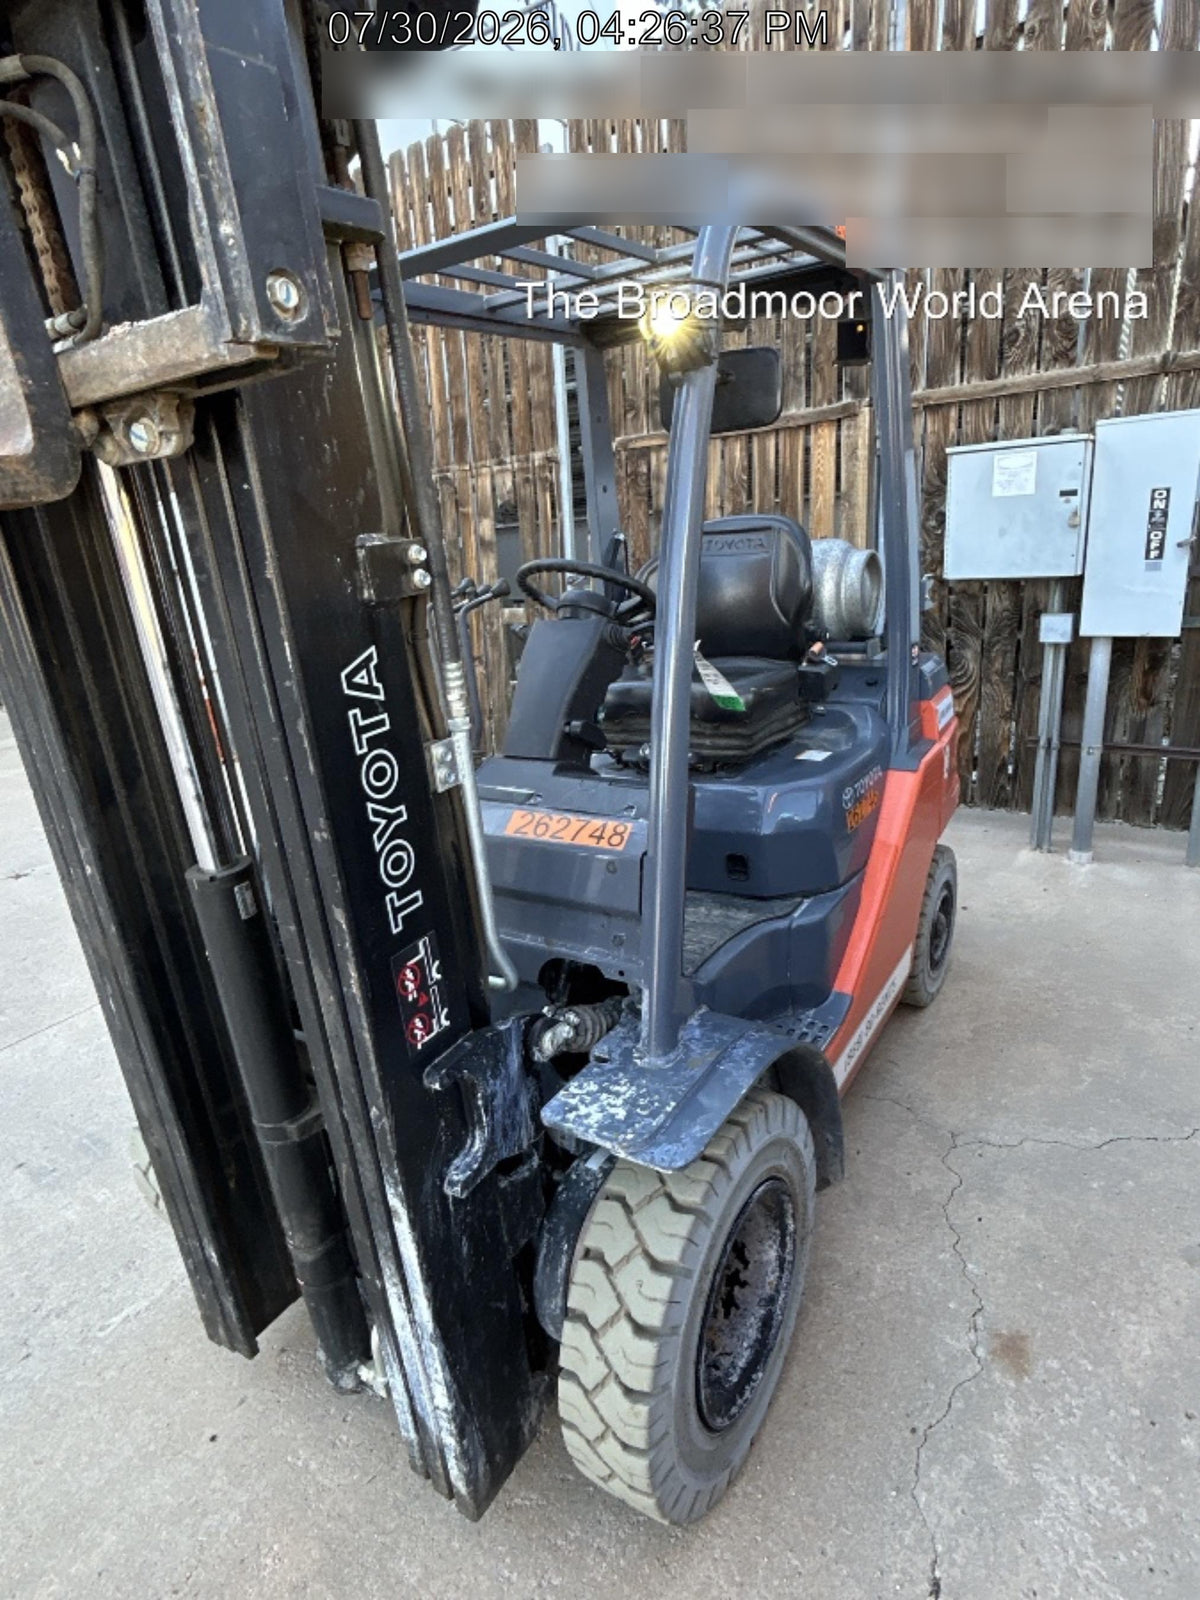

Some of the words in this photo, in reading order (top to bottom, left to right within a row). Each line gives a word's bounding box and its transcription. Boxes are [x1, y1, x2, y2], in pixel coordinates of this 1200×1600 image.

[1153, 490, 1168, 509] ON
[705, 537, 767, 552] TOYOTA
[1149, 530, 1163, 559] OFF
[340, 644, 424, 935] TOYOTA
[512, 811, 629, 848] 262748
